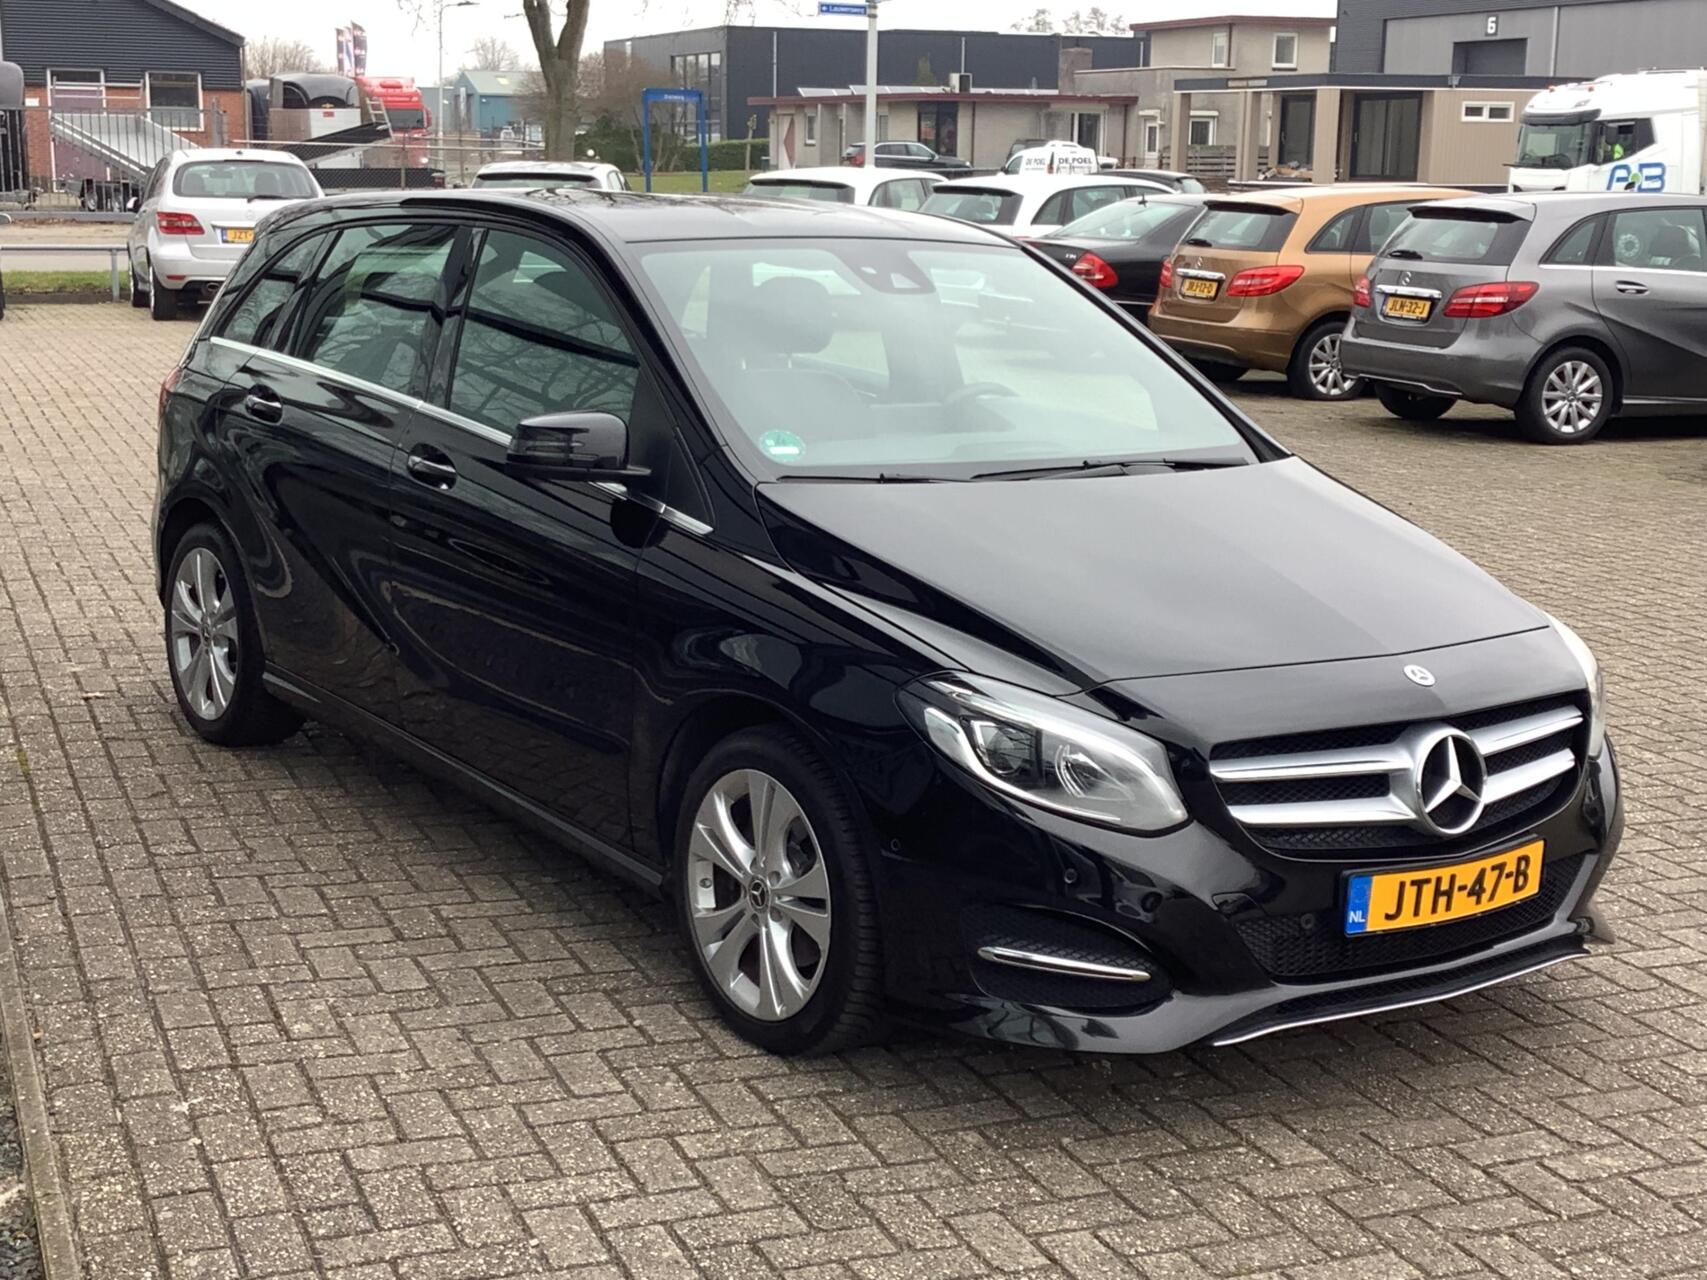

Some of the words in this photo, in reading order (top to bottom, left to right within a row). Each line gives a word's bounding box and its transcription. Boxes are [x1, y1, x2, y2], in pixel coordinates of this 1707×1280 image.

[1487, 16, 1497, 34] 6
[1071, 157, 1093, 165] POEL
[1389, 299, 1427, 315] JLN-32-J
[1384, 854, 1531, 921] JTH-47-B
[1348, 910, 1366, 923] NL
